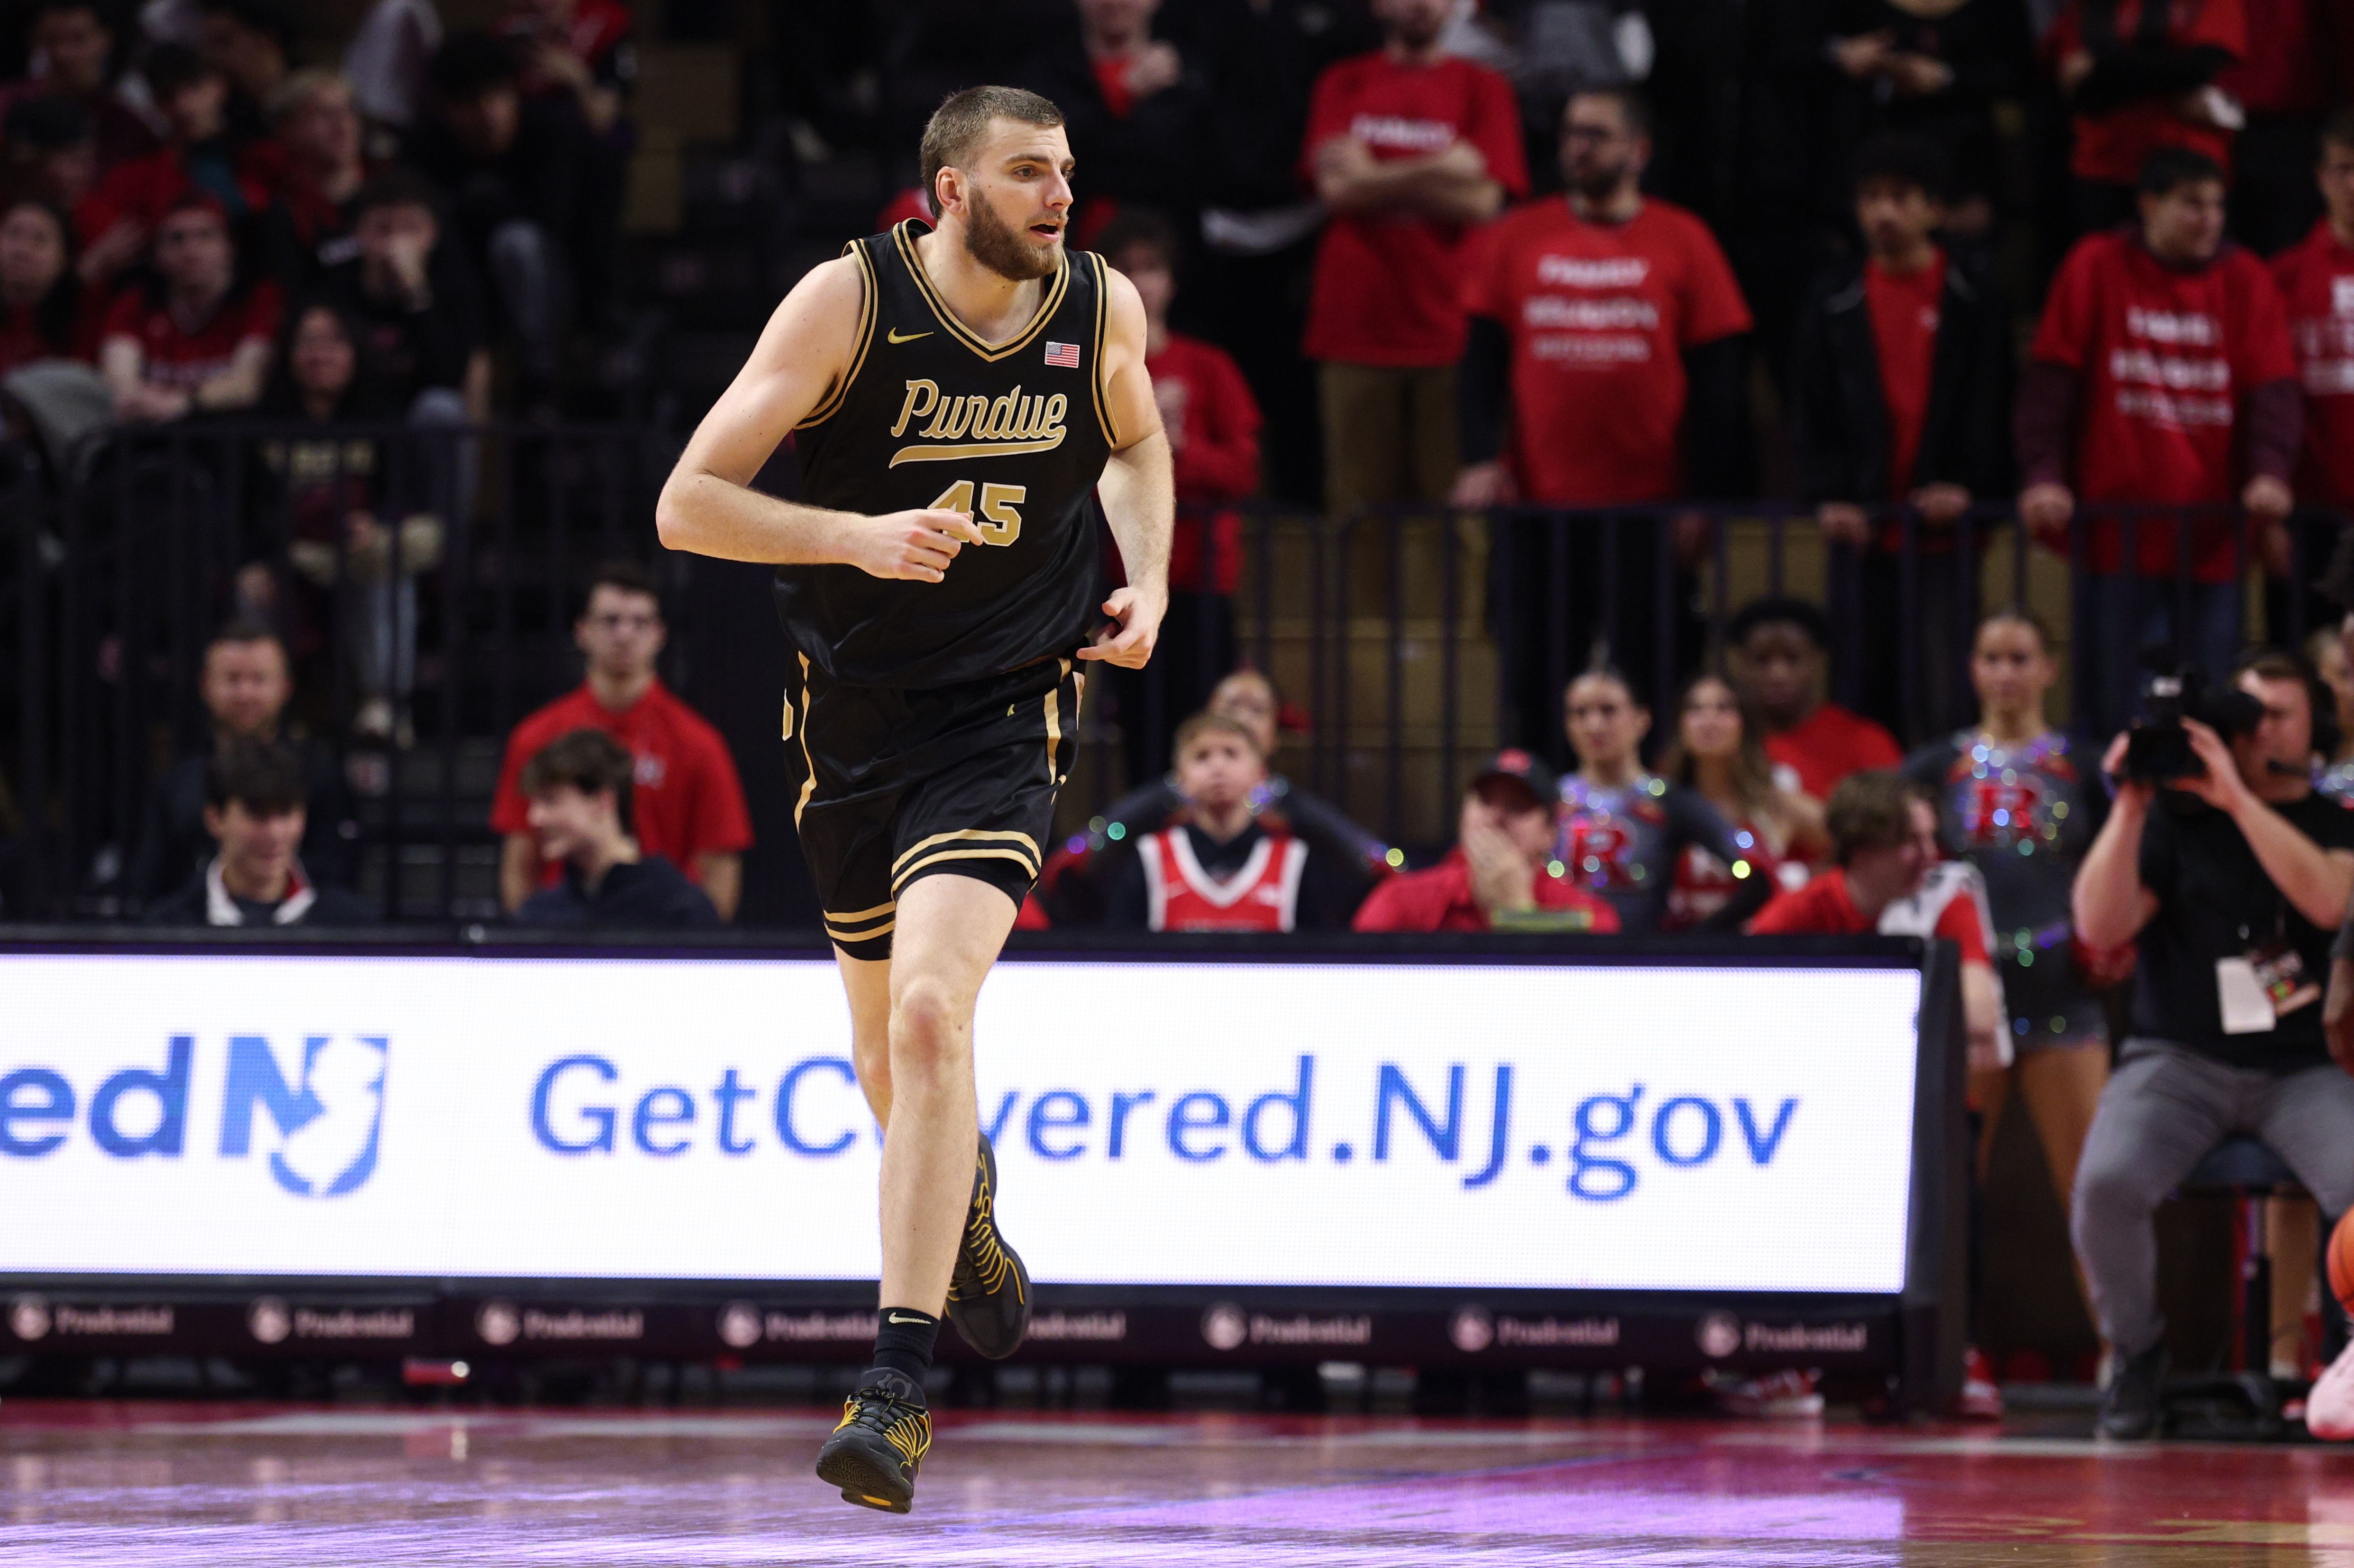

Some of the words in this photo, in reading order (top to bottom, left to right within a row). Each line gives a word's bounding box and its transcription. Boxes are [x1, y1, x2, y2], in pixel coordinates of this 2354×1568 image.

[889, 378, 1067, 464] Purdue
[927, 479, 1026, 547] 45
[529, 1053, 1800, 1201] GetCvered.NJ.gov
